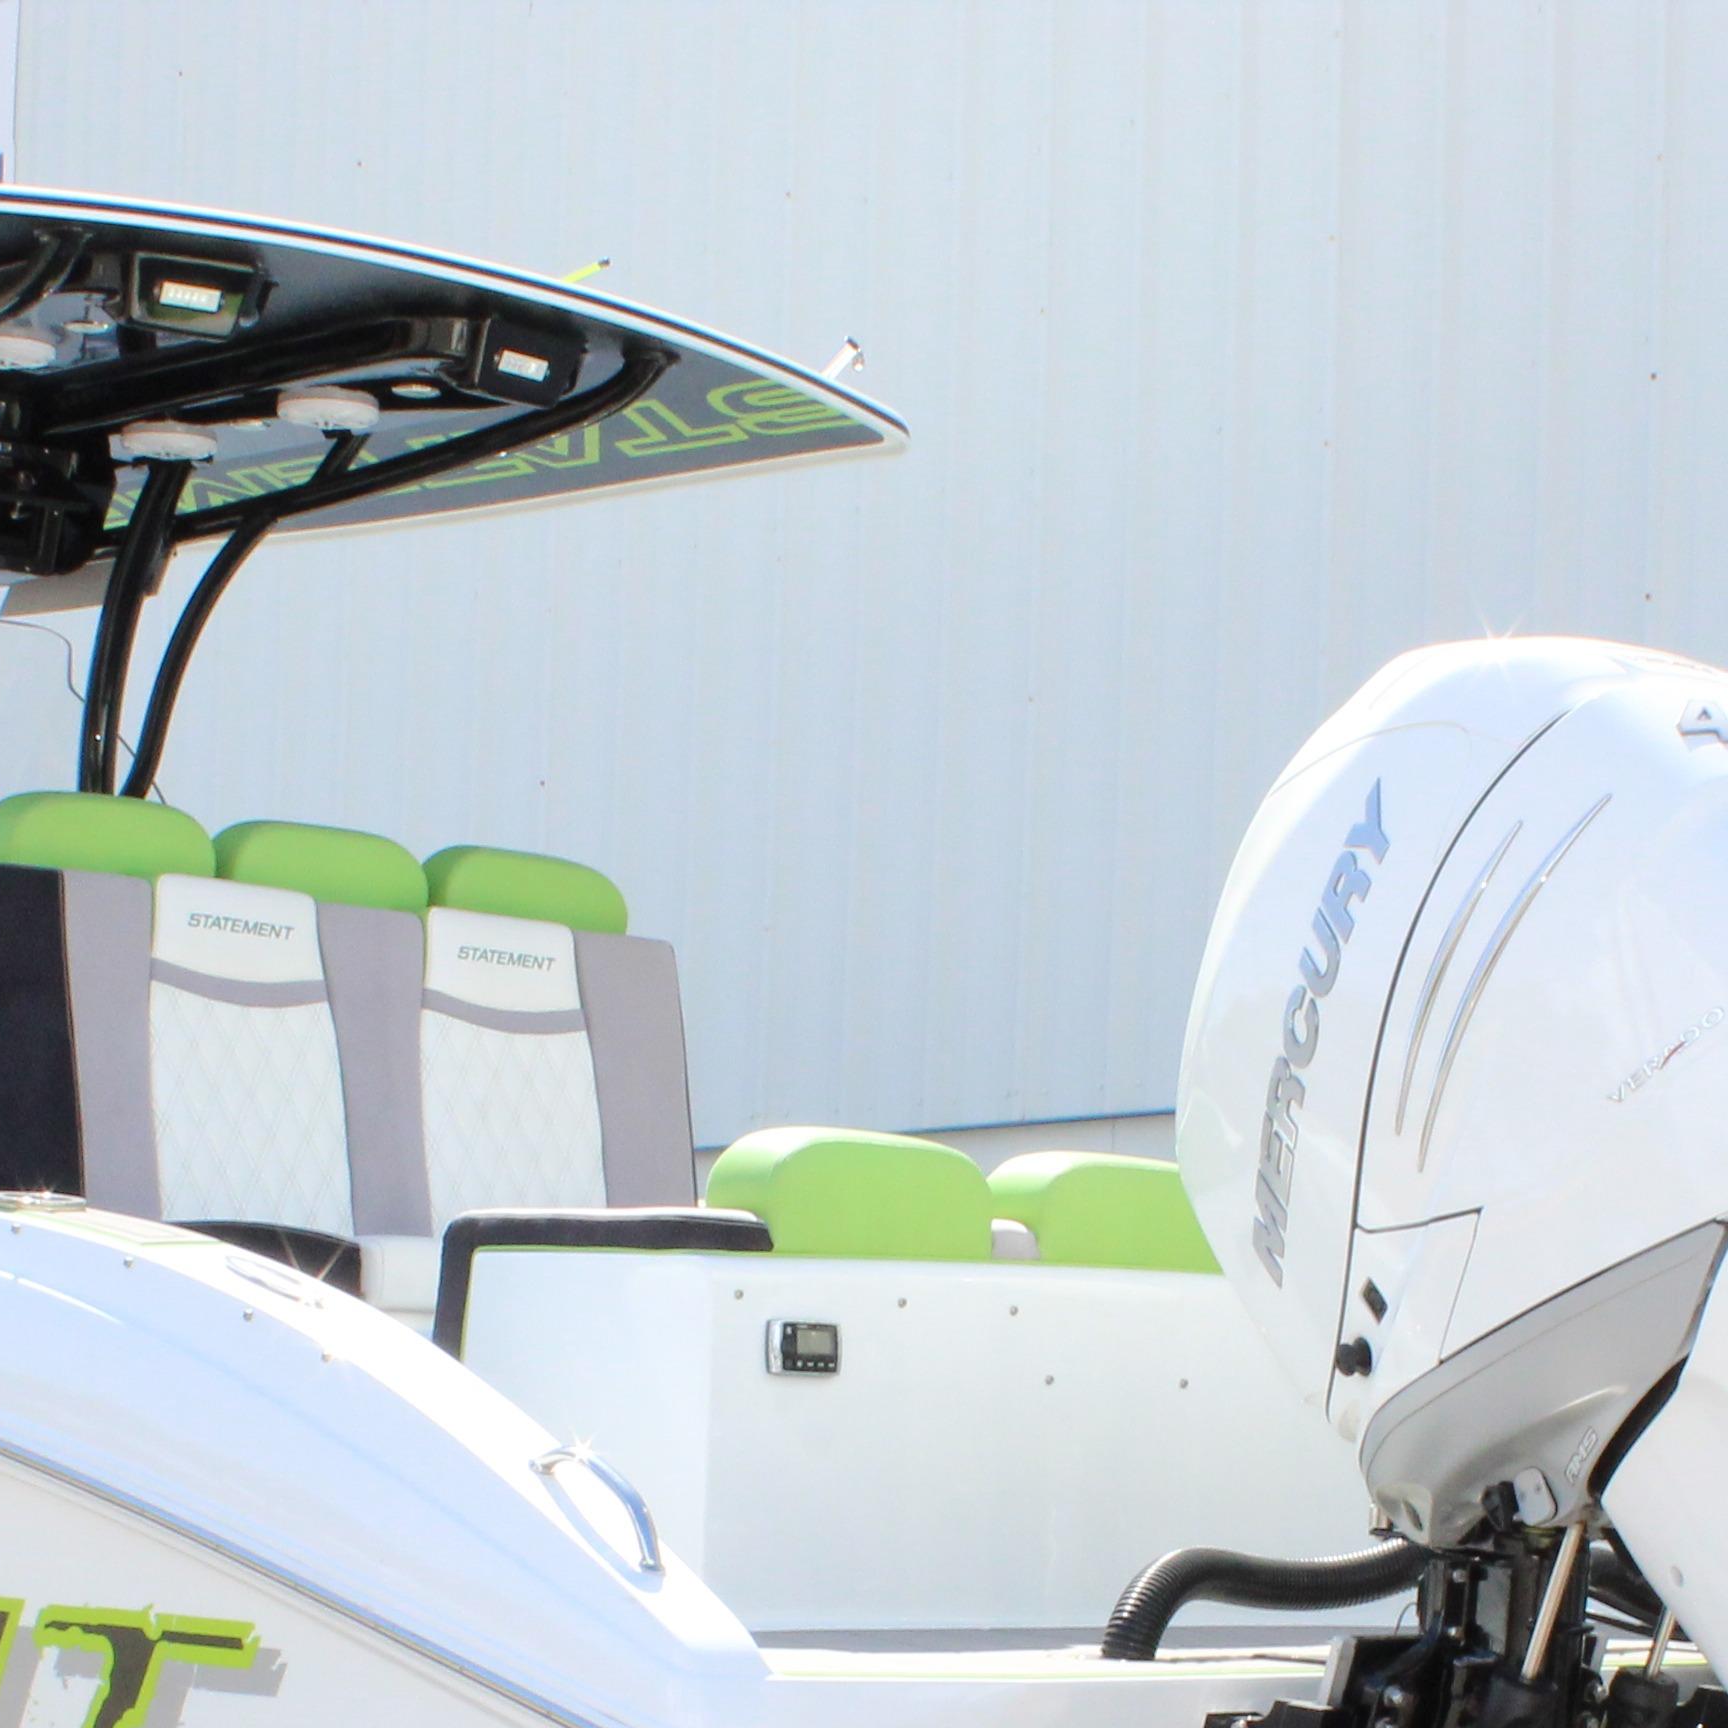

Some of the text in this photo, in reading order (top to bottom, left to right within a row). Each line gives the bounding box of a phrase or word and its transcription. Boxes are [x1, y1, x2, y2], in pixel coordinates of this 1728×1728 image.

[187, 912, 295, 941] STATEMENT
[456, 945, 556, 972] STATEMENT
[1251, 776, 1390, 1290] MERCURY
[1606, 1005, 1725, 1103] VERADO
